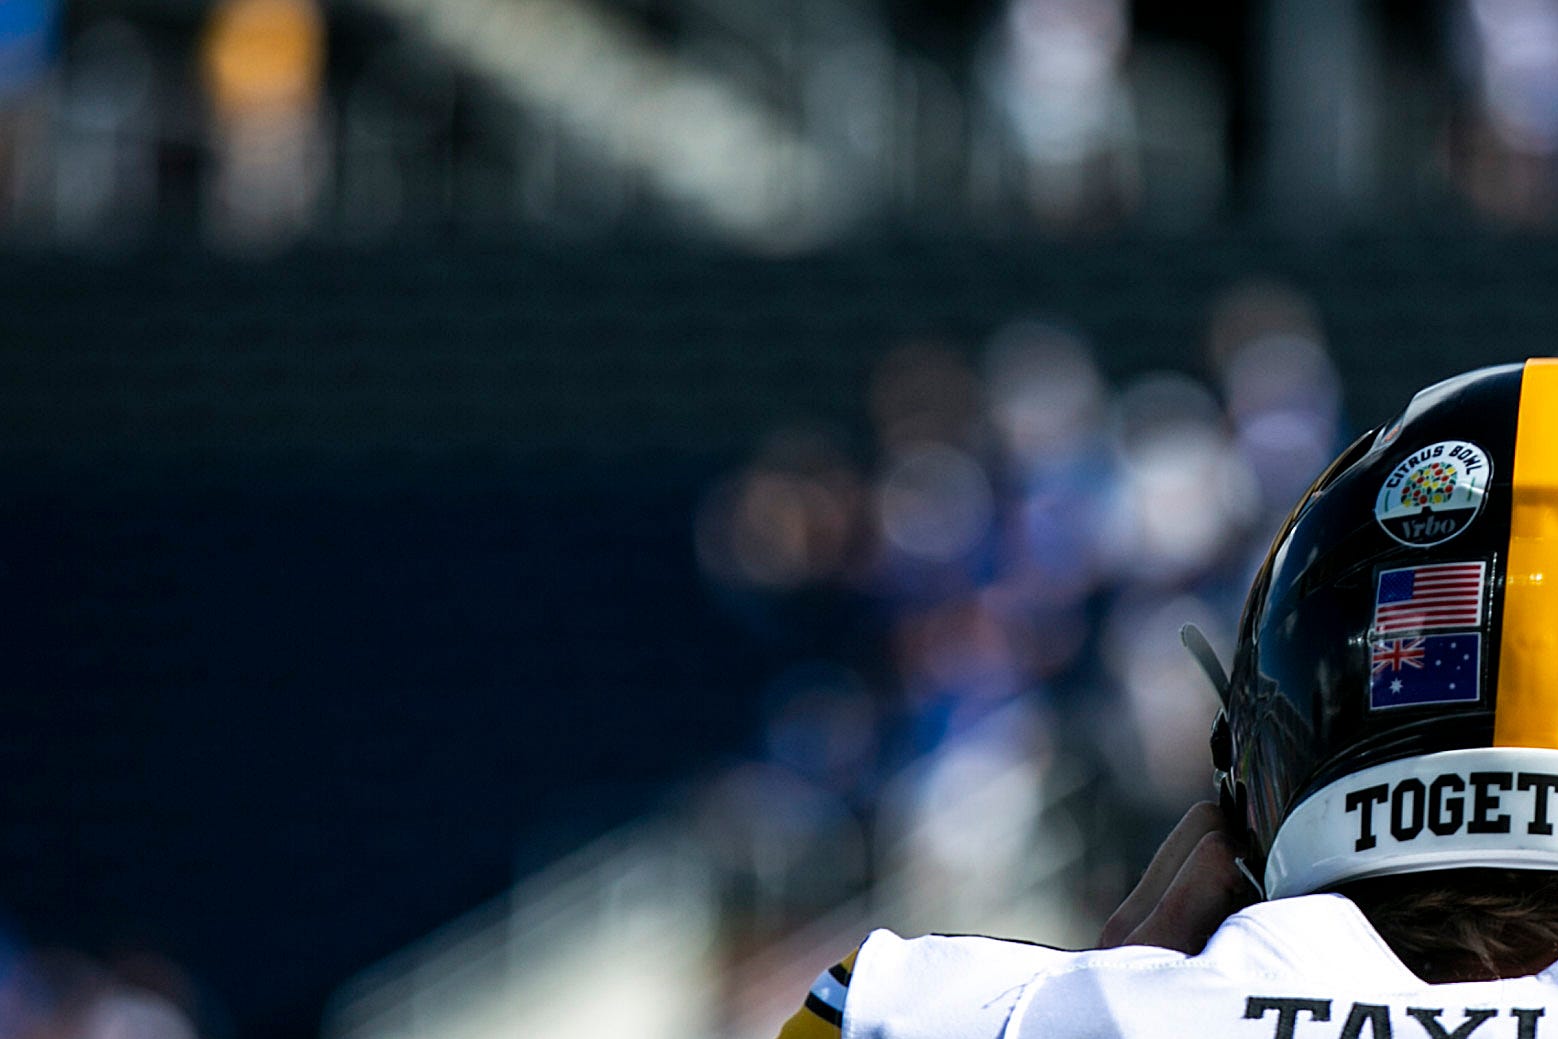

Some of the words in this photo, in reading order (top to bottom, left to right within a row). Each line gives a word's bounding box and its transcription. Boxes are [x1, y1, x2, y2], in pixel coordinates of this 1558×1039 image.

[1386, 447, 1444, 488] CITRUS
[1449, 446, 1483, 475] BOWL
[1402, 516, 1456, 539] Vrbo
